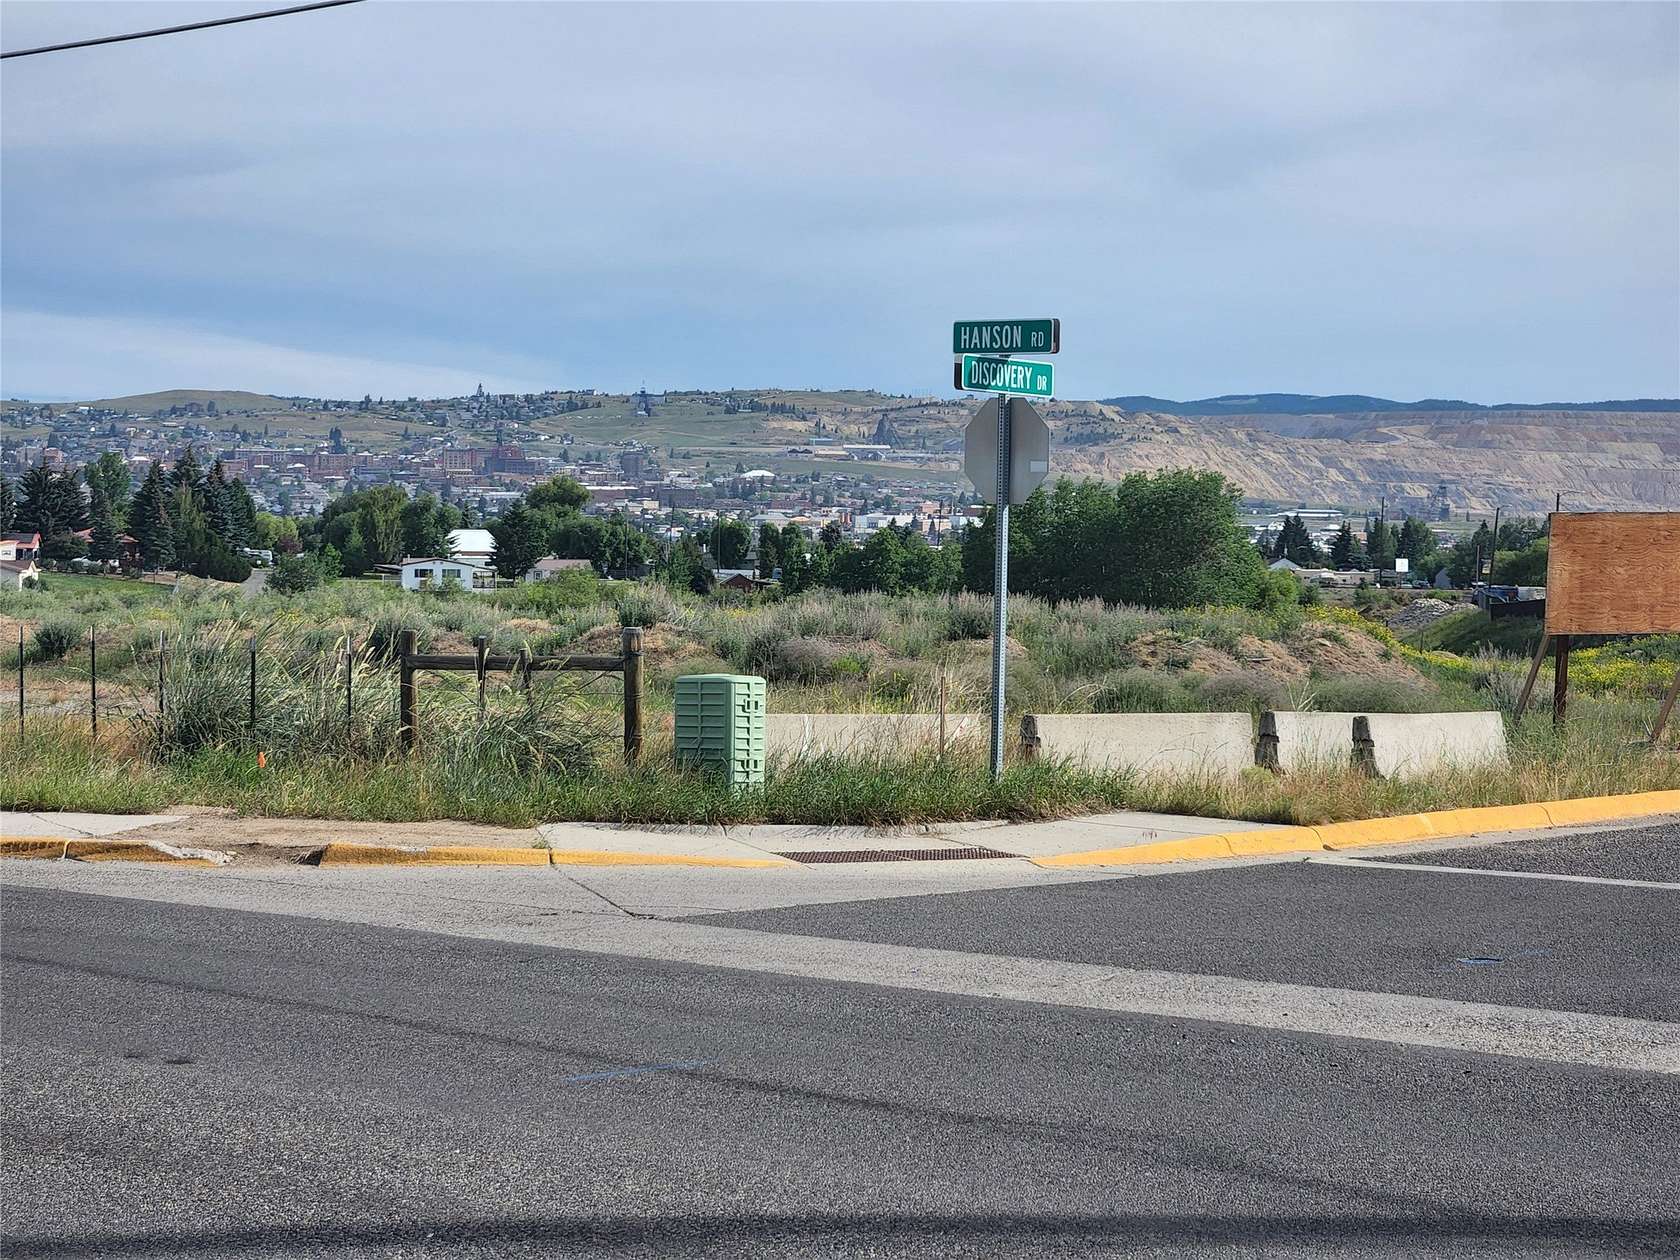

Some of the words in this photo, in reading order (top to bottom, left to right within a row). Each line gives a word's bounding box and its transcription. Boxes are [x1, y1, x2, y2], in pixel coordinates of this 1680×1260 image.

[961, 325, 1022, 349] HANSON
[1031, 331, 1044, 347] RD
[971, 361, 1032, 389] DISCOVERY
[1037, 375, 1047, 391] DR
